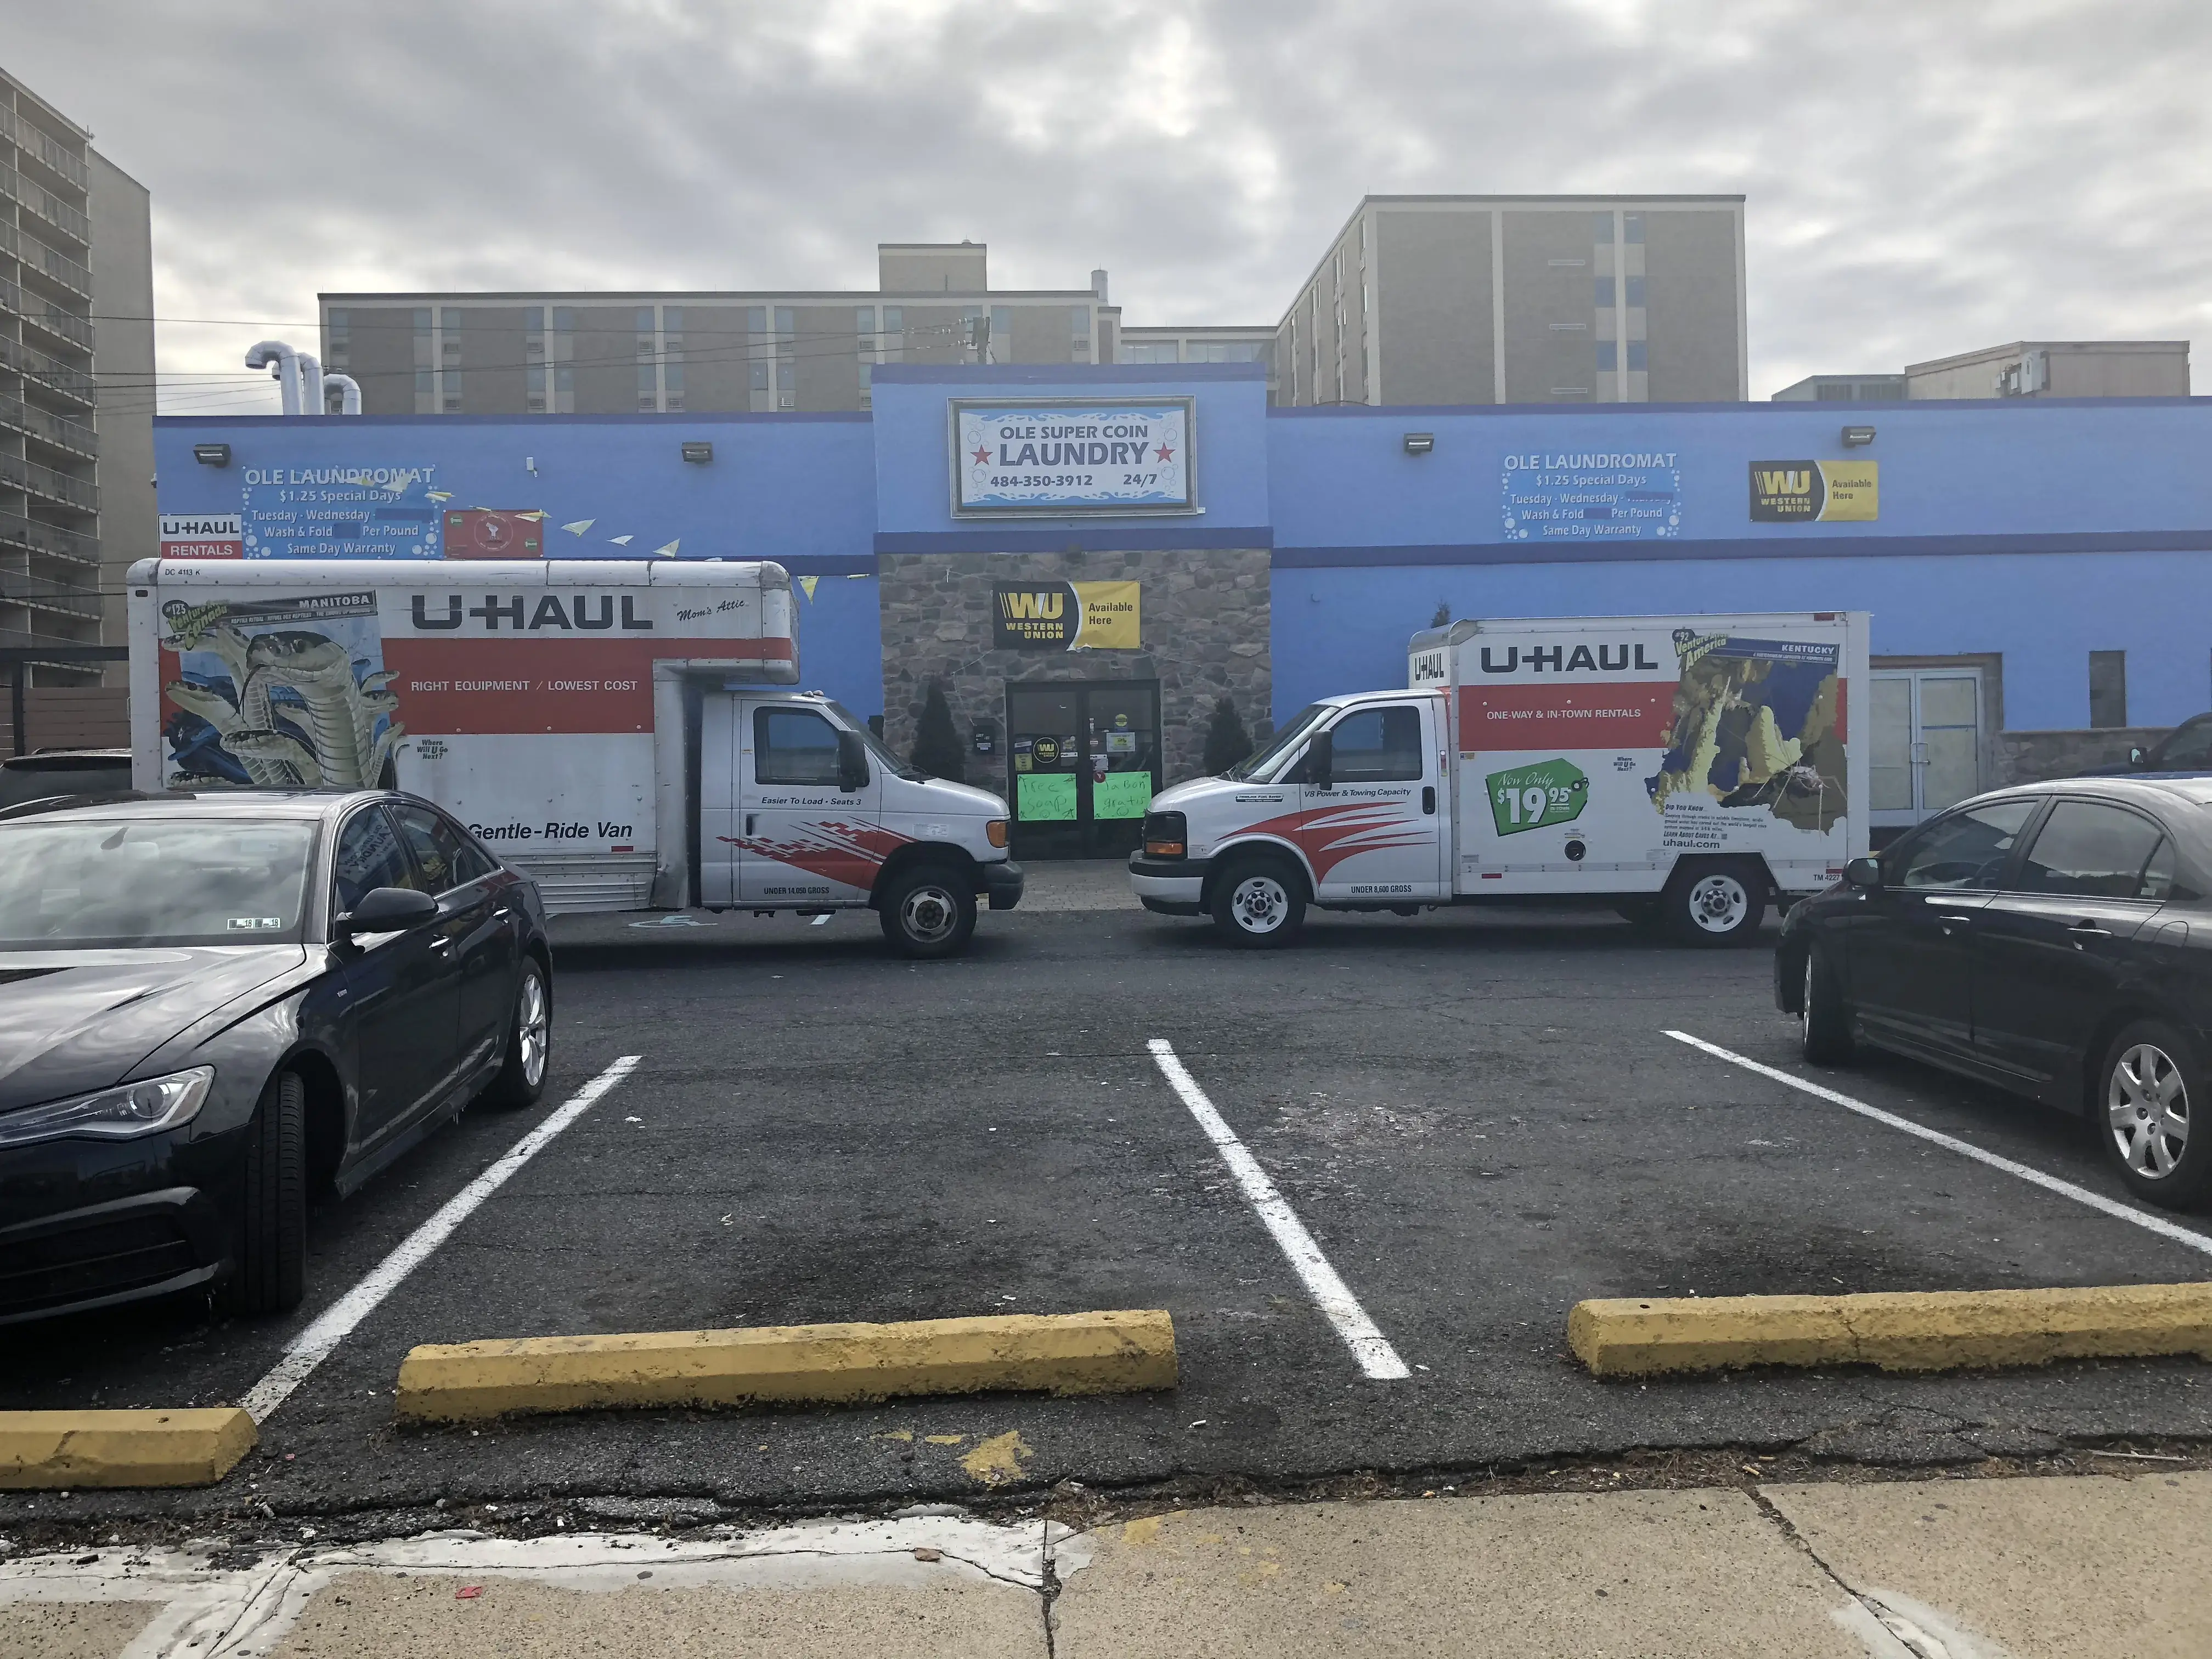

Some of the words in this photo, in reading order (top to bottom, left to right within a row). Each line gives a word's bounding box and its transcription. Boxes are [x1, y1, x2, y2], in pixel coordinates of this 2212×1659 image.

[1000, 427, 1036, 439] OLE
[1041, 426, 1098, 439] SUPER
[1102, 426, 1148, 438] COIN
[1000, 442, 1149, 466] LAUNDRY
[1504, 455, 1540, 470] OLE
[1545, 453, 1677, 470] LAUNDROMAT
[245, 469, 285, 485] OLE
[991, 475, 1093, 487] 484-350-3912
[1124, 474, 1157, 488] 24/7
[1536, 474, 1569, 487] $1.25
[1573, 474, 1614, 487] Special
[1617, 474, 1646, 487] Days
[1832, 479, 1872, 488] Available
[280, 490, 317, 503] $1.25
[320, 490, 367, 504] Special
[370, 490, 401, 503] Days
[1510, 494, 1552, 506] Tuesday
[1560, 493, 1618, 505] Wednesday
[1833, 492, 1853, 500] Here
[252, 510, 297, 523] Tuesday
[307, 510, 370, 523] Wednesday
[1521, 509, 1549, 520] Wash
[1552, 509, 1560, 520] &
[1562, 509, 1584, 519] Fold
[1611, 509, 1628, 518] Per
[1630, 507, 1662, 518] Pound
[163, 522, 239, 534] U-HAUL
[264, 526, 295, 537] Wash
[298, 526, 305, 537] &
[309, 525, 333, 537] Fold
[363, 526, 380, 537] Per
[383, 525, 419, 536] Pound
[1543, 524, 1569, 535] Same
[1572, 524, 1591, 538] Day
[1594, 524, 1642, 537] Warranty
[171, 545, 233, 556] RENTALS
[287, 543, 316, 554] Same
[319, 543, 340, 556] Day
[343, 543, 397, 556] Warranty
[299, 595, 370, 608] MANITOBA
[1088, 602, 1133, 612] Available
[412, 595, 653, 630] U-HAUL
[676, 606, 712, 621] Mom's
[716, 600, 744, 613] Attic
[1089, 616, 1111, 625] Here
[185, 606, 228, 649] Canada
[1024, 631, 1063, 639] UNION
[1675, 636, 1709, 656] Venture
[1782, 645, 1835, 654] KENTUCKY
[1481, 644, 1658, 673] U-HAUL
[1686, 639, 1726, 672] America
[1414, 653, 1444, 681] U-HAUL
[411, 681, 449, 691] RIGHT
[455, 680, 531, 692] EQUIPMENT
[548, 680, 600, 691] LOWEST
[604, 680, 638, 691] COST
[1487, 710, 1533, 720] ONE-WAY
[1536, 710, 1544, 719] &
[1547, 709, 1592, 719] IN-TOWN
[1595, 709, 1641, 718] RENTALS
[1498, 773, 1523, 786] Now
[1526, 772, 1555, 789] Only
[1350, 789, 1376, 798] Towing
[467, 822, 589, 839] Gentle-Ride
[597, 822, 633, 838] Van
[1663, 839, 1720, 849] uhaul.com
[1351, 885, 1372, 894] UNDER
[1374, 885, 1389, 894] 8,600
[1391, 885, 1412, 893] GROSS
